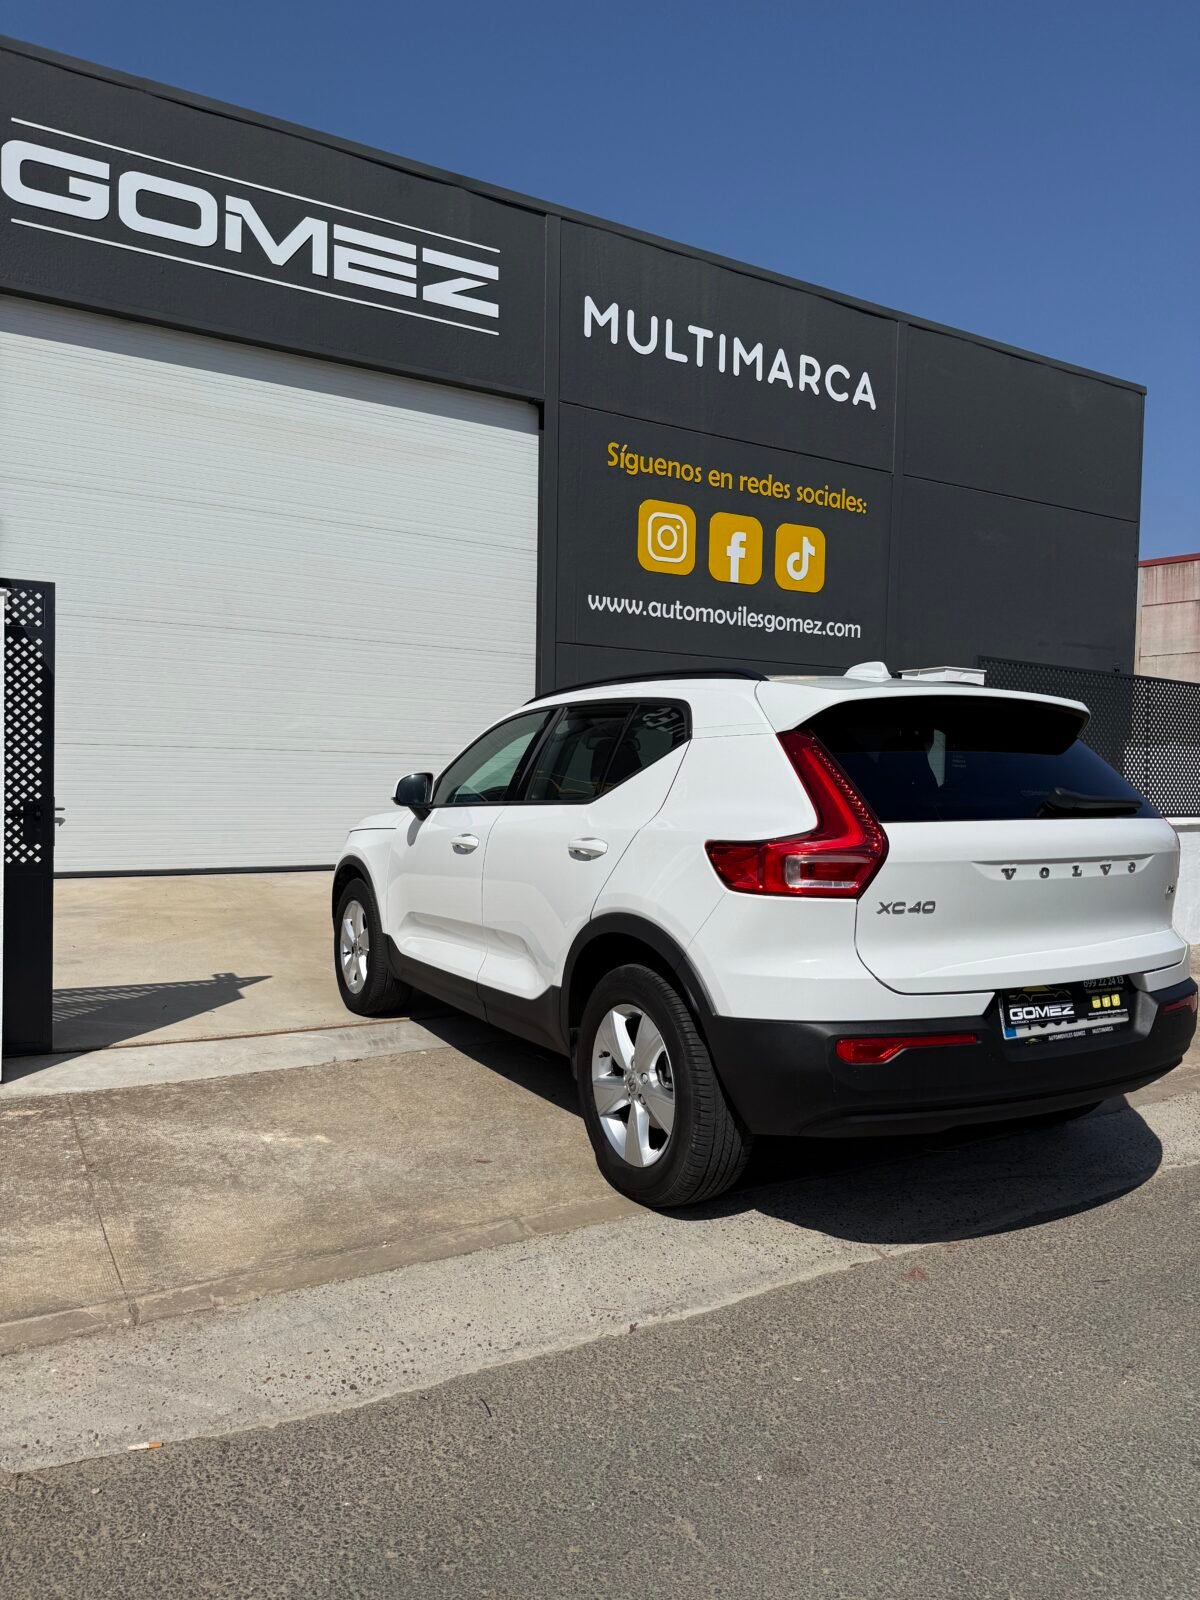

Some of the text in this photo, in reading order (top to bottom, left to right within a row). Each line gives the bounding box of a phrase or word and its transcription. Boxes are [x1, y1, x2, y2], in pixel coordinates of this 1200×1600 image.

[0, 139, 500, 318] GOMEZ
[584, 296, 876, 411] MULTIMARCA
[607, 442, 868, 515] Síguenos en redes sociales:
[588, 594, 861, 638] www.automovilesgomez.com
[1001, 862, 1136, 881] VOLVO
[1009, 1004, 1075, 1021] GOMEZ
